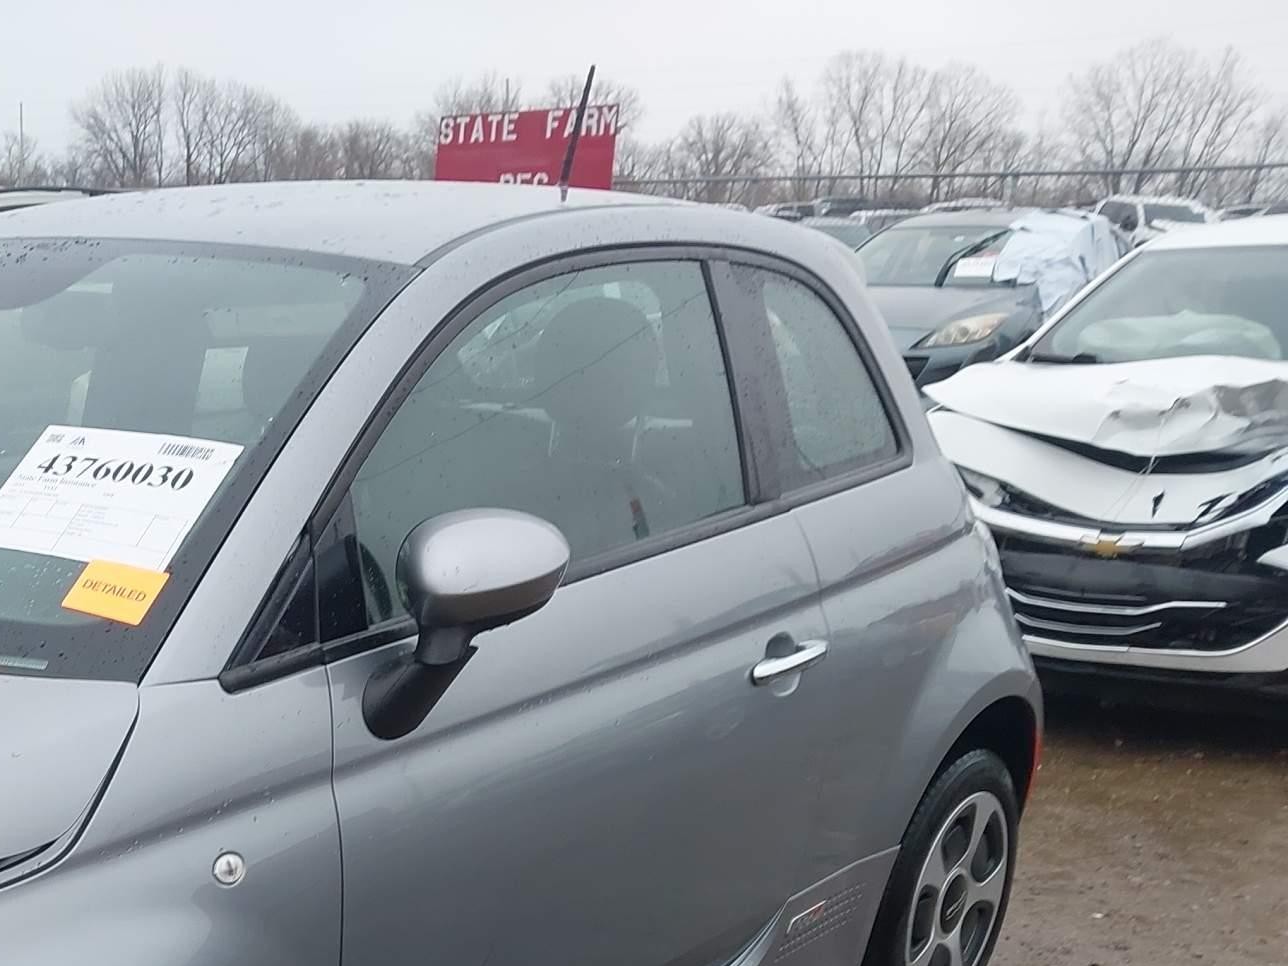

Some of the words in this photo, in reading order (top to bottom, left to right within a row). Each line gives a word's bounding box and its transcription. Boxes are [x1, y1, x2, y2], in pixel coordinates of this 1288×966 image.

[439, 112, 519, 145] STATE
[545, 106, 618, 139] FARM
[37, 453, 194, 491] 43760030
[81, 579, 147, 602] DETAILED
